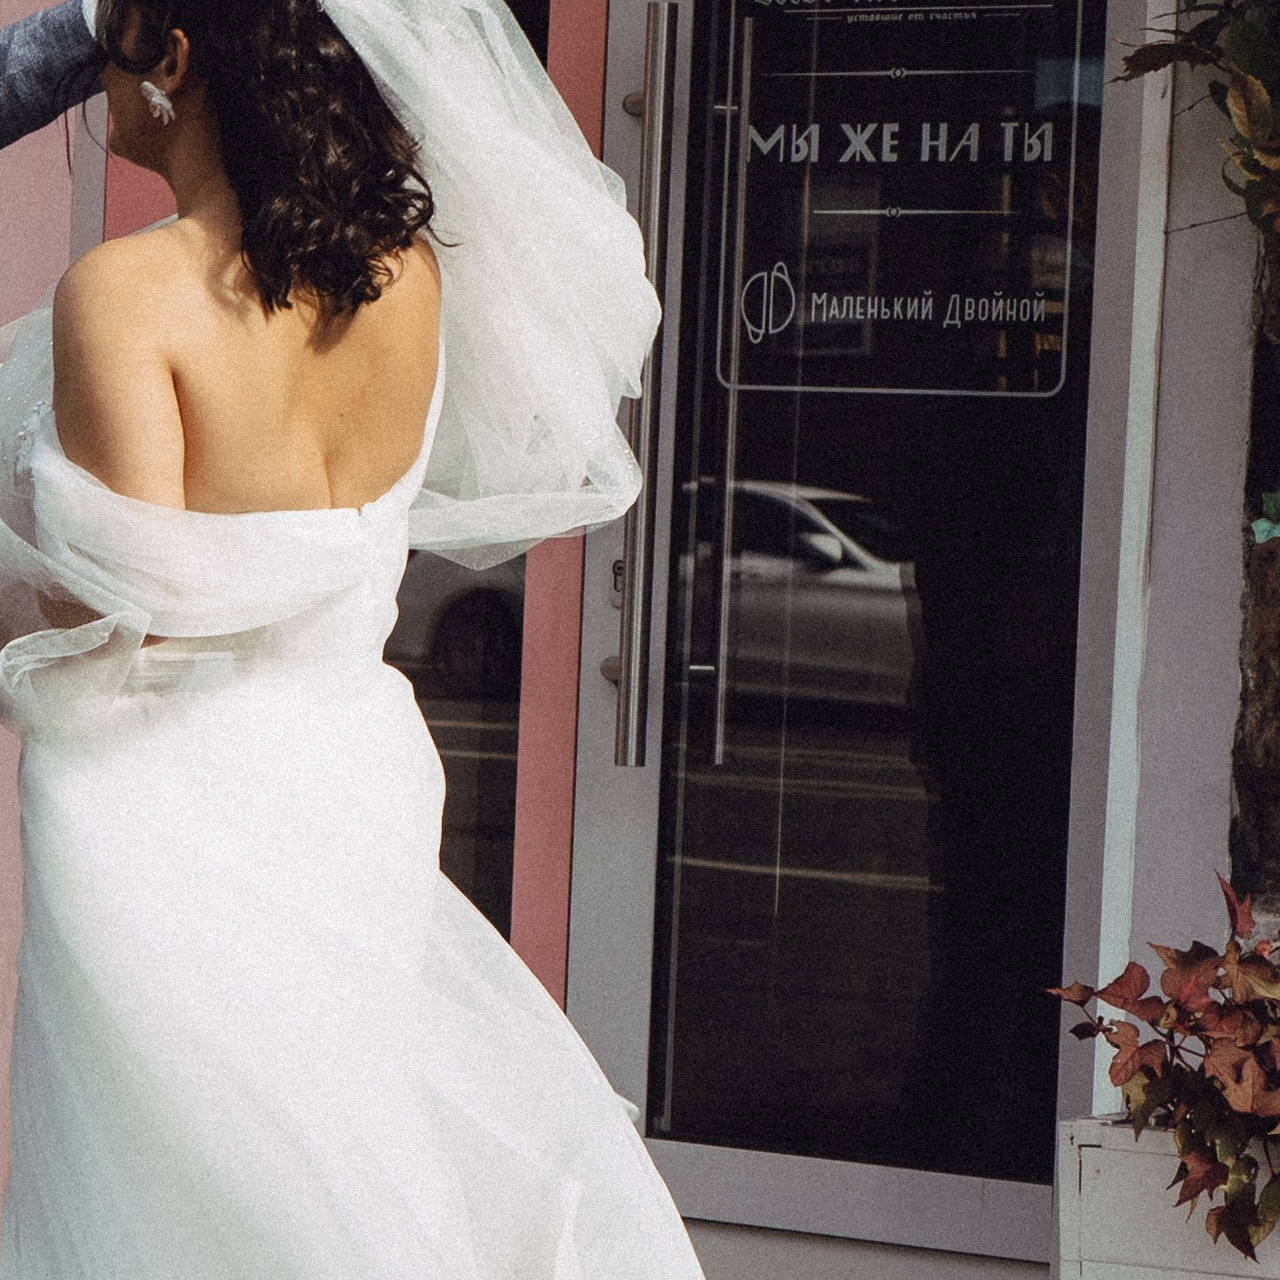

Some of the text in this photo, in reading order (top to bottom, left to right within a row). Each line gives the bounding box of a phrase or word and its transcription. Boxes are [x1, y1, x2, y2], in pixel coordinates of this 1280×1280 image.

[746, 122, 1054, 163] МЫ ЖЕ НА ТЫ
